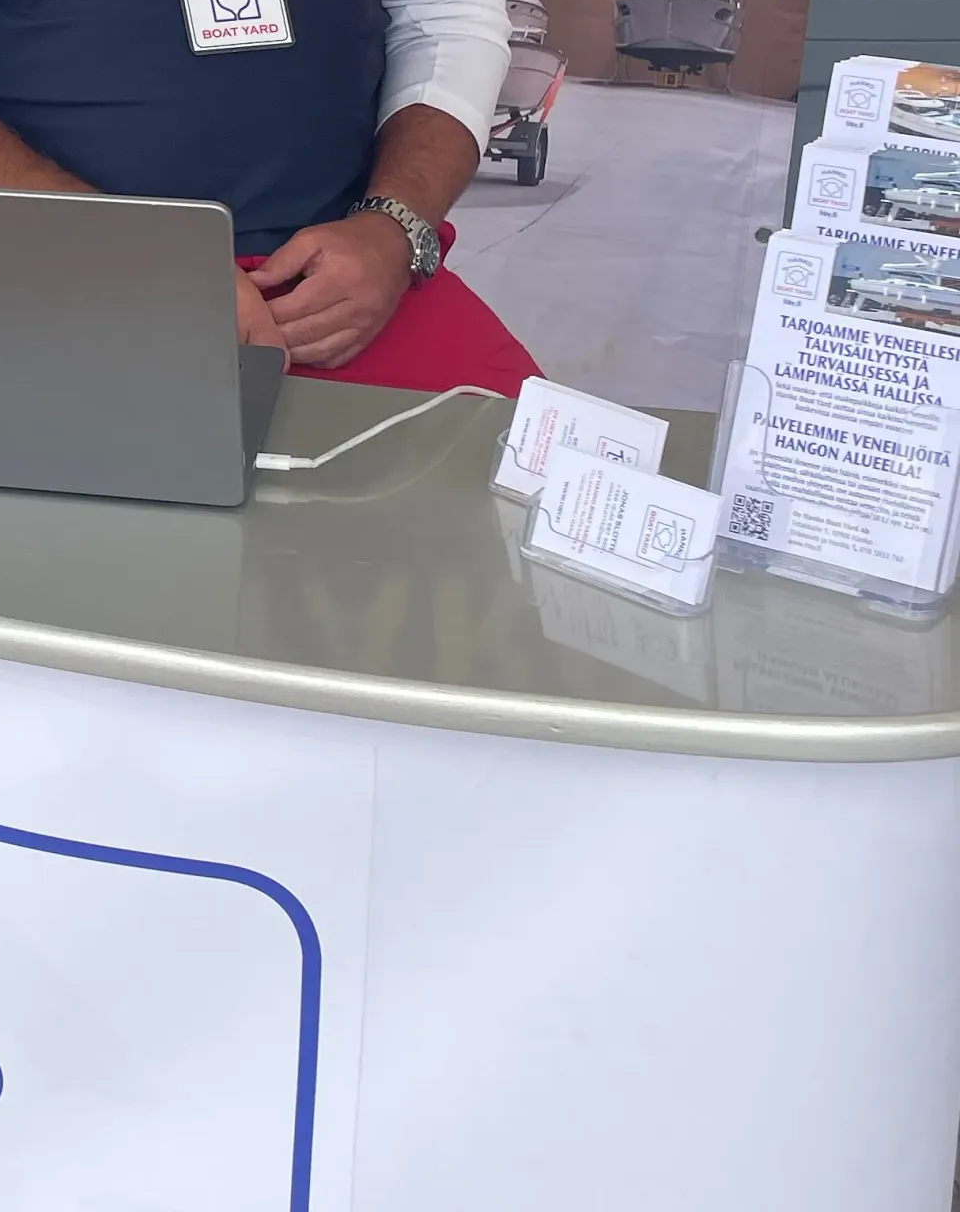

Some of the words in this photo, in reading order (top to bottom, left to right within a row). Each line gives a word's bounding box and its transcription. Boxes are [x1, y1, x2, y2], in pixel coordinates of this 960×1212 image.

[202, 27, 239, 39] BOAT
[242, 24, 279, 35] YARD
[780, 315, 870, 344] TARJOAMME
[874, 332, 960, 362] VENEELLESI
[805, 336, 929, 372] TALVISÄILYTYSTÄ
[775, 362, 869, 394] LÄMPIMÄSSÄ
[874, 384, 942, 406] HALLISSA
[798, 351, 909, 385] TURVALLISESSA
[912, 375, 930, 390] JA
[753, 412, 848, 444] PALVELEMME
[852, 433, 951, 467] VENEILIJÖITÄ
[775, 435, 840, 460] HANGON
[843, 451, 922, 479] ALUEELLA!
